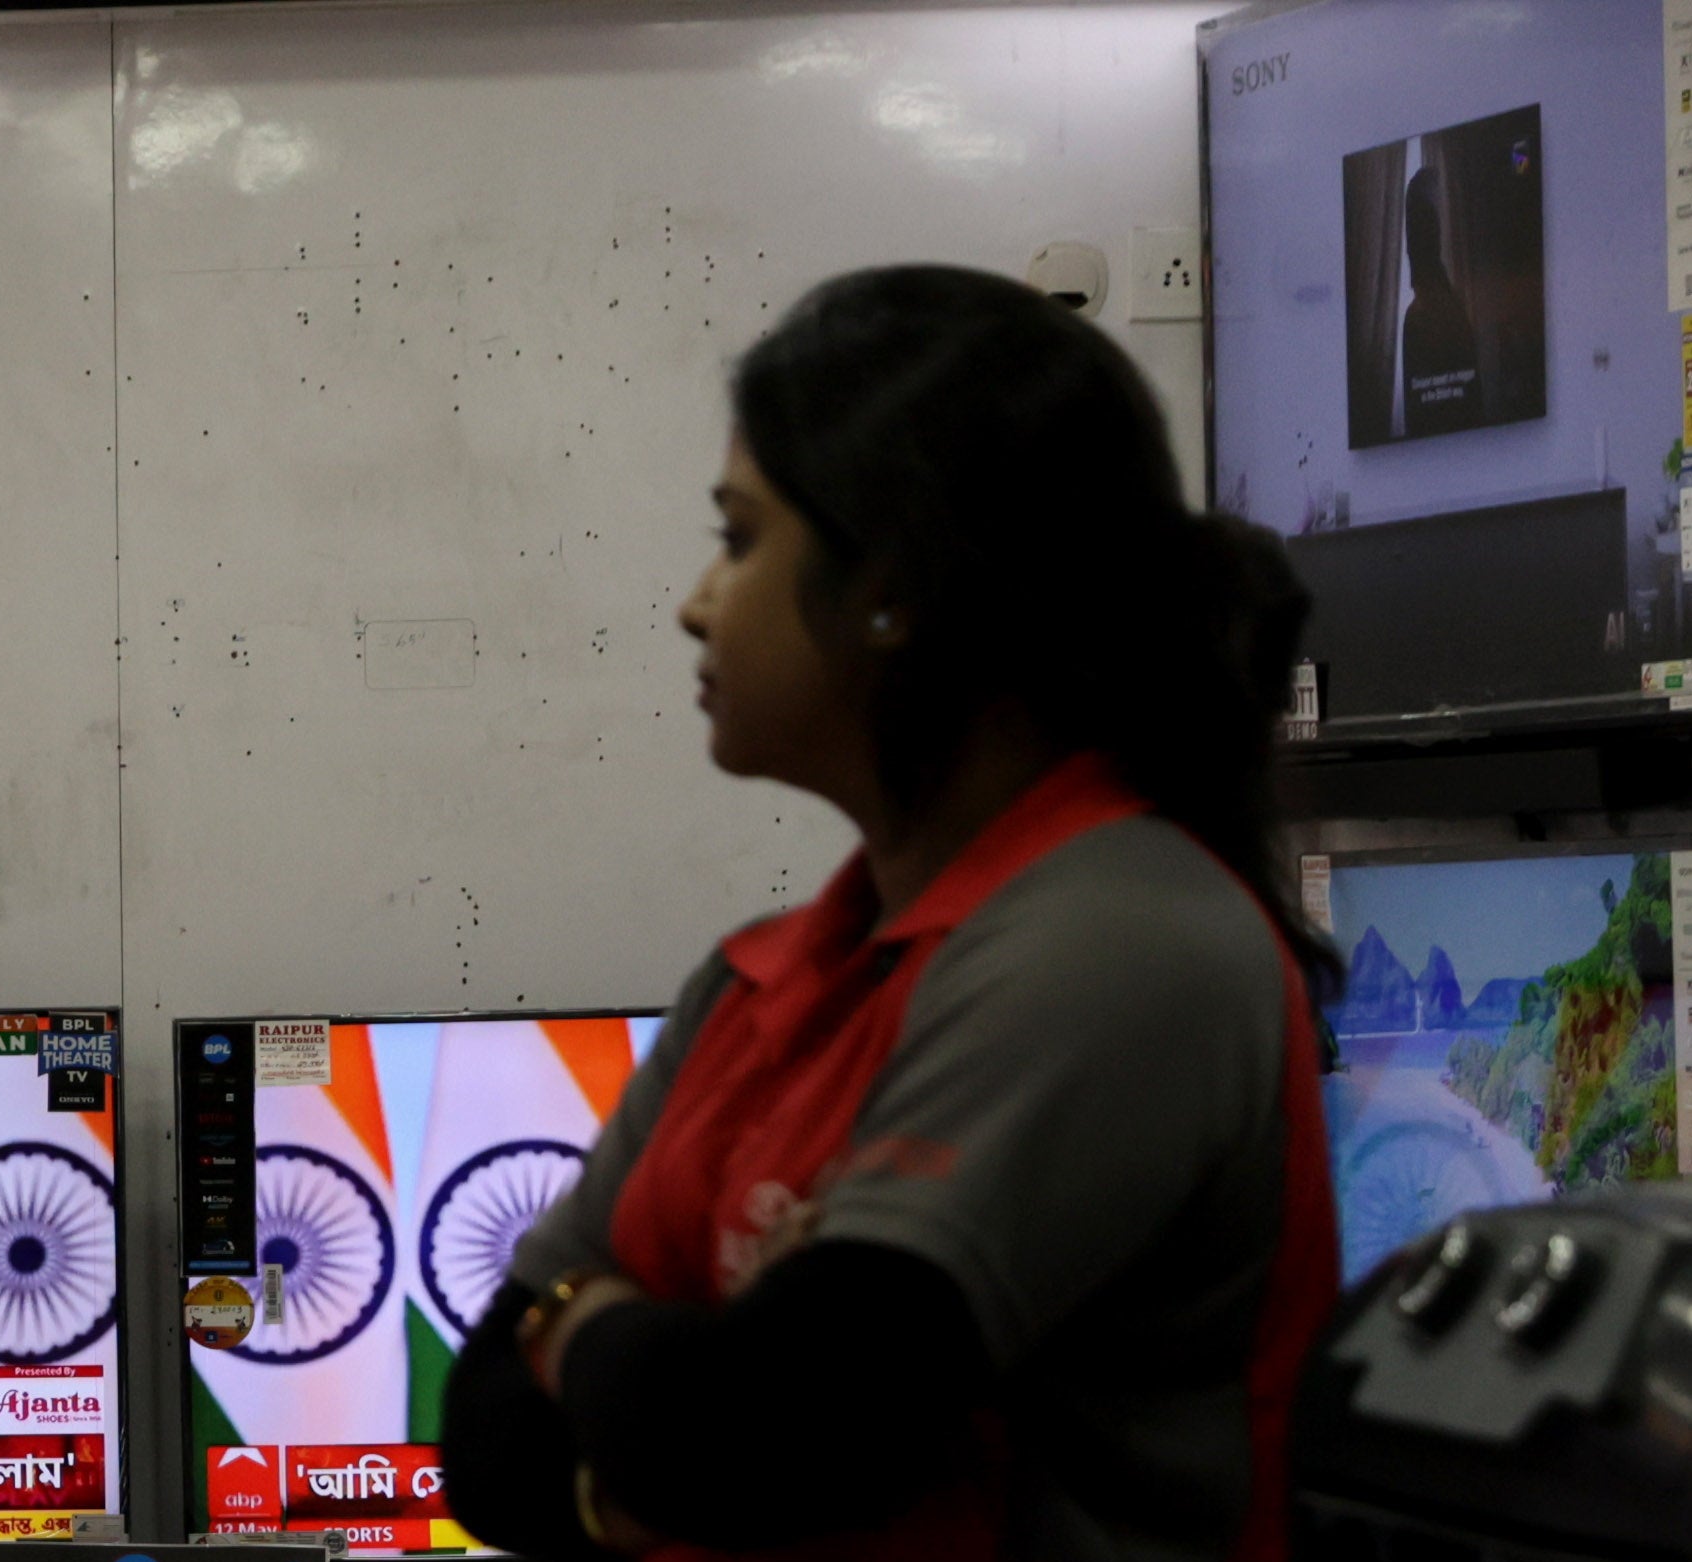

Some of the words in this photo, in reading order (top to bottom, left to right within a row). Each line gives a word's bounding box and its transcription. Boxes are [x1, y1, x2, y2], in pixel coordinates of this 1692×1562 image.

[1232, 51, 1290, 96] SONY
[62, 1018, 94, 1031] BPL
[259, 1025, 325, 1036] RAIPUR
[42, 1034, 112, 1051] HOME
[259, 1036, 326, 1044] ELECTRONICS
[203, 1043, 231, 1055] BPL
[43, 1051, 112, 1070] THEATER
[67, 1070, 88, 1082] TV
[14, 1366, 62, 1376] Presented
[63, 1366, 76, 1377] By
[36, 1415, 70, 1423] SHOES
[296, 1453, 398, 1500] 'আমি
[224, 1492, 263, 1508] abp
